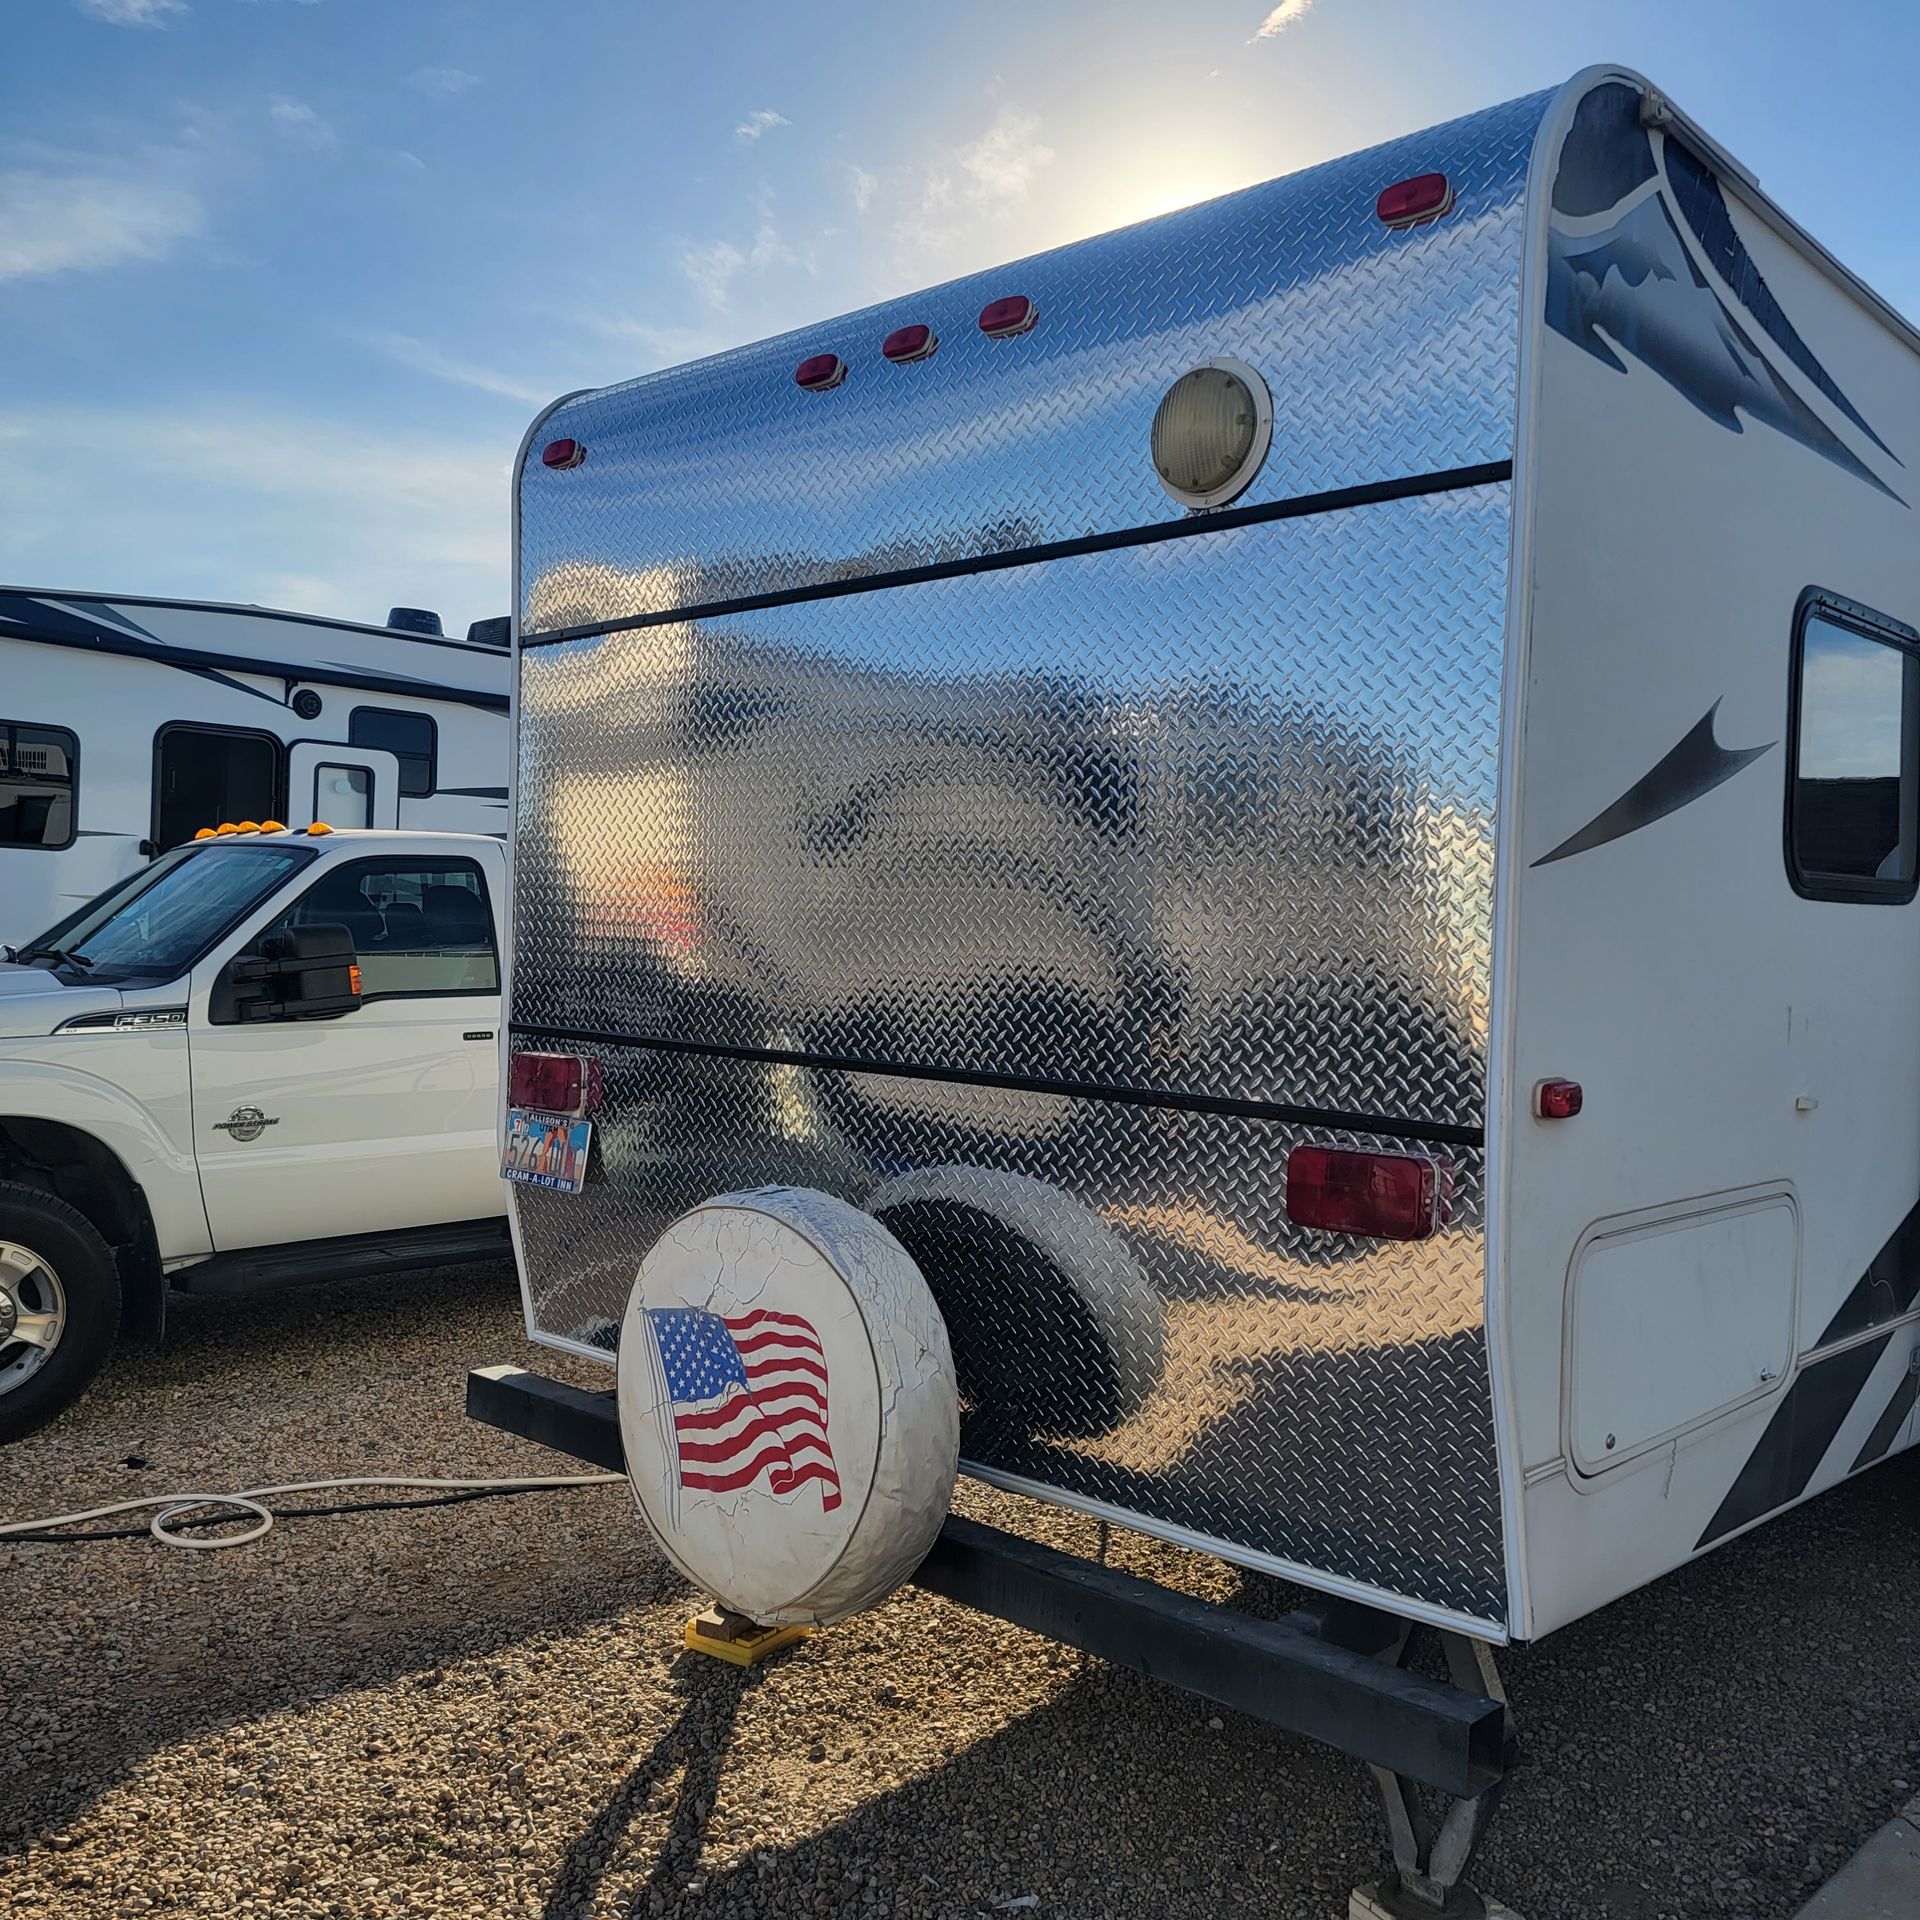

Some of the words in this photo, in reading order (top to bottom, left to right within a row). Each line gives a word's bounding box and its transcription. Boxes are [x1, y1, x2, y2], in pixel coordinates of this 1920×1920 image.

[530, 1114, 568, 1127] ALLISON'S
[506, 1169, 556, 1187] CRAM-A-LOT
[557, 1178, 573, 1190] INN
